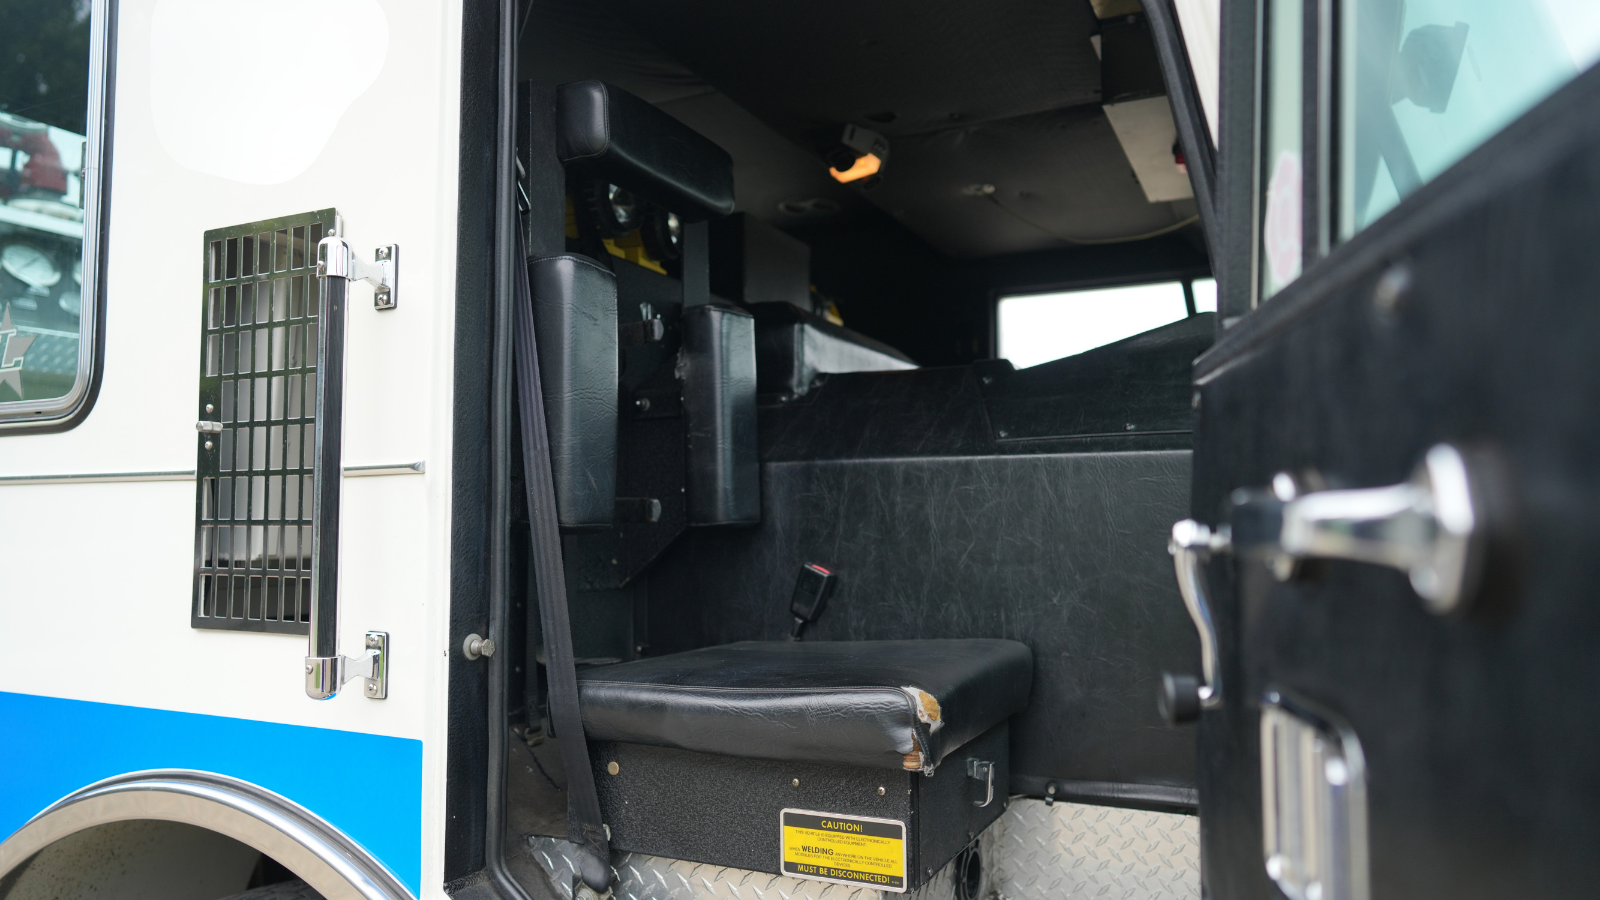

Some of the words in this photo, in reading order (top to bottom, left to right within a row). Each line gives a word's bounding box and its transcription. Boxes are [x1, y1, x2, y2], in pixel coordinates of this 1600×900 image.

[821, 820, 863, 832] CAUTION!
[802, 845, 834, 855] WELDING
[798, 864, 817, 873] MUST
[831, 869, 890, 883] DISCONNECTED!
